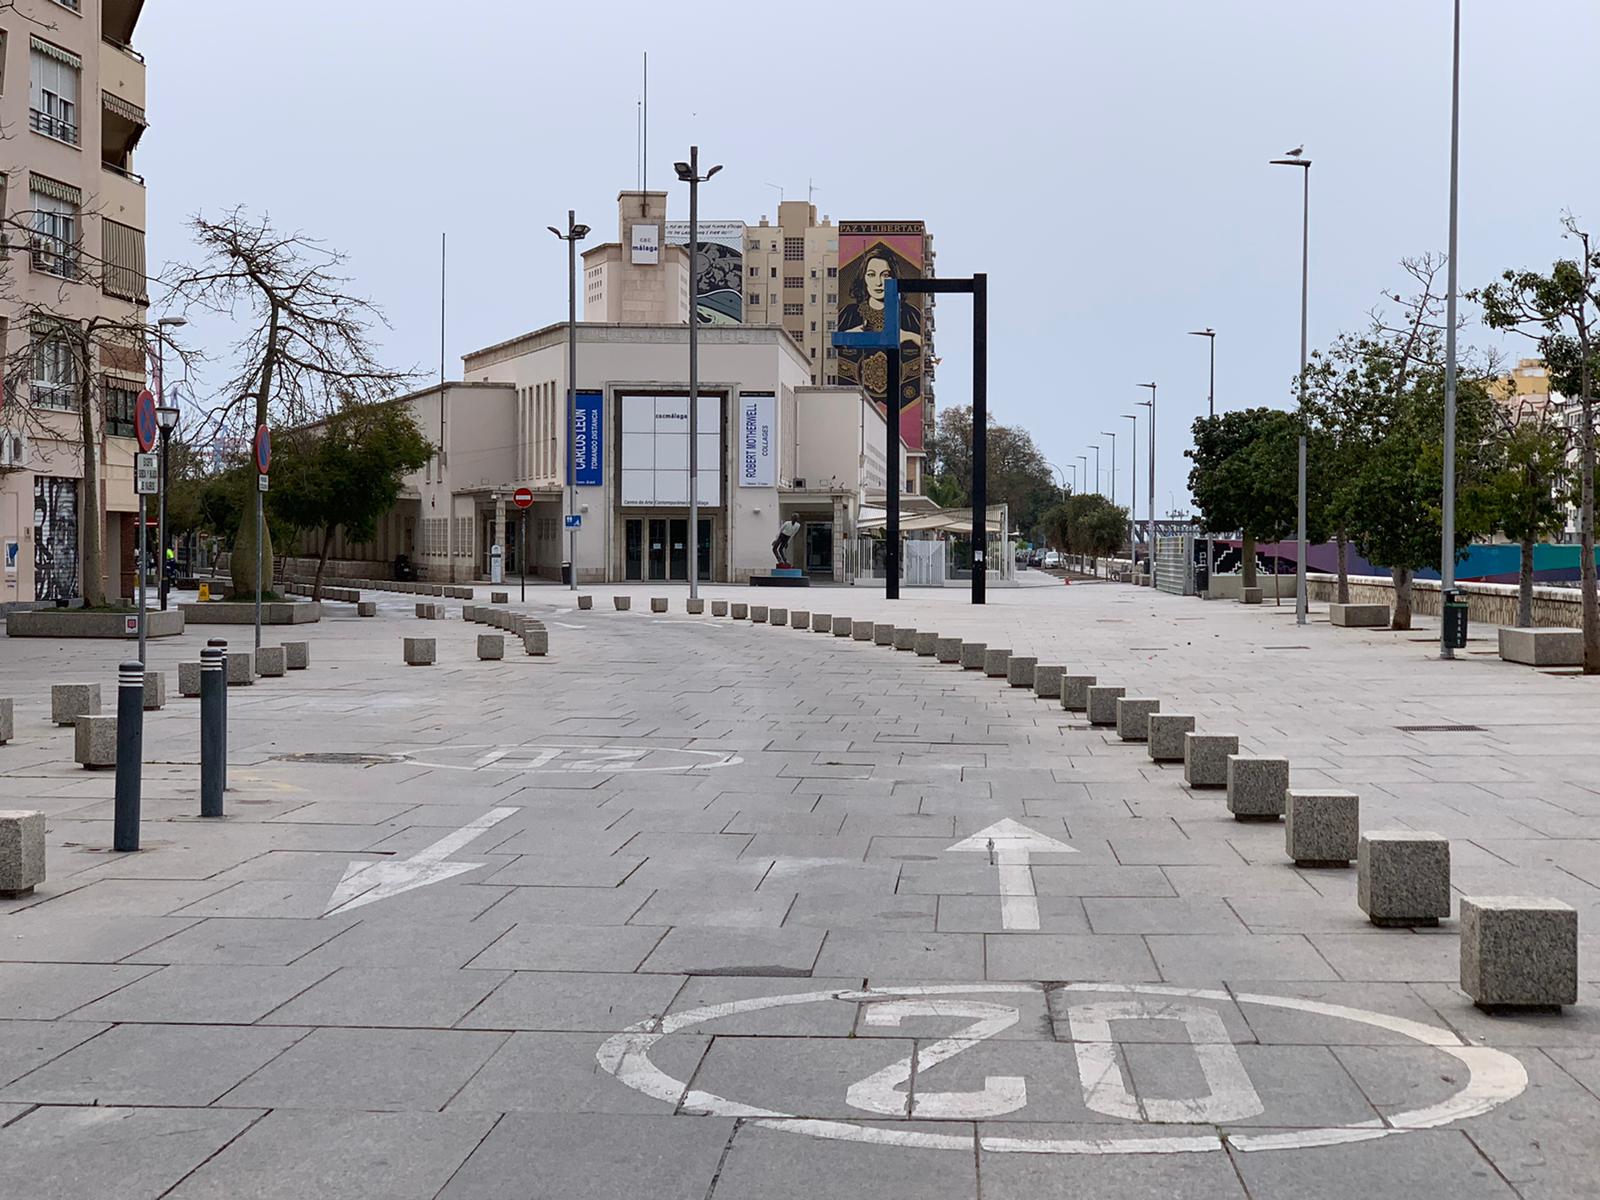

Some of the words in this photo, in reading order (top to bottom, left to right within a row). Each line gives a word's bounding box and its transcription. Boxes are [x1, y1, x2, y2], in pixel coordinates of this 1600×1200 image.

[840, 224, 858, 232] PAZ
[861, 224, 867, 232] Y
[870, 224, 921, 232] LIBERTAD
[746, 403, 757, 450] MOTHERWELL
[575, 434, 586, 470] CARLOS
[746, 450, 757, 478] ROBERT
[845, 999, 1266, 1124] 20
